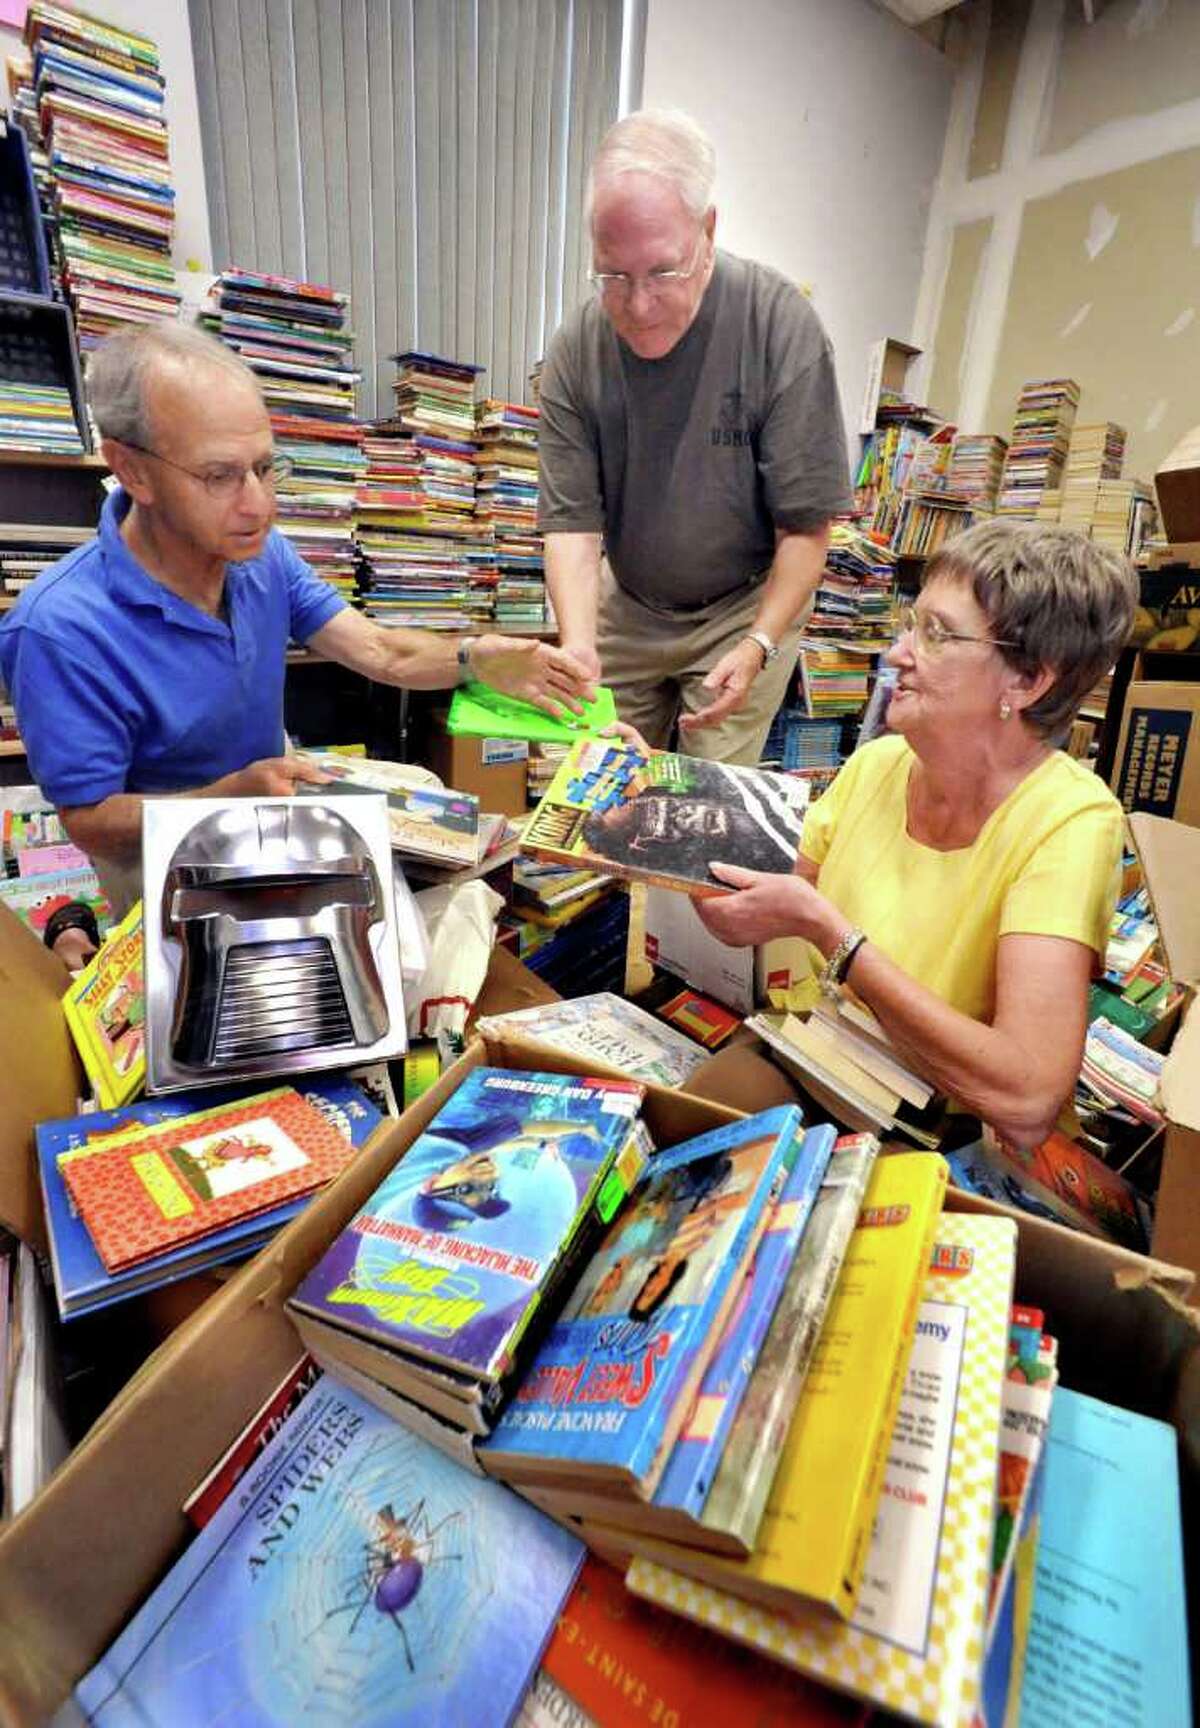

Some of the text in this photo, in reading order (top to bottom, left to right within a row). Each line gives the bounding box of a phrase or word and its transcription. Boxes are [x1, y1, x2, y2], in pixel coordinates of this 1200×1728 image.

[1139, 733, 1161, 800] RECORDS
[1153, 734, 1180, 802] MEYER
[352, 1214, 426, 1246] MANHATTAN
[427, 1230, 443, 1250] OF
[446, 1235, 512, 1271] HIJACKING
[511, 1257, 540, 1282] THE
[256, 1400, 349, 1528] SPIDERS
[248, 1413, 365, 1582] AND WEBS
